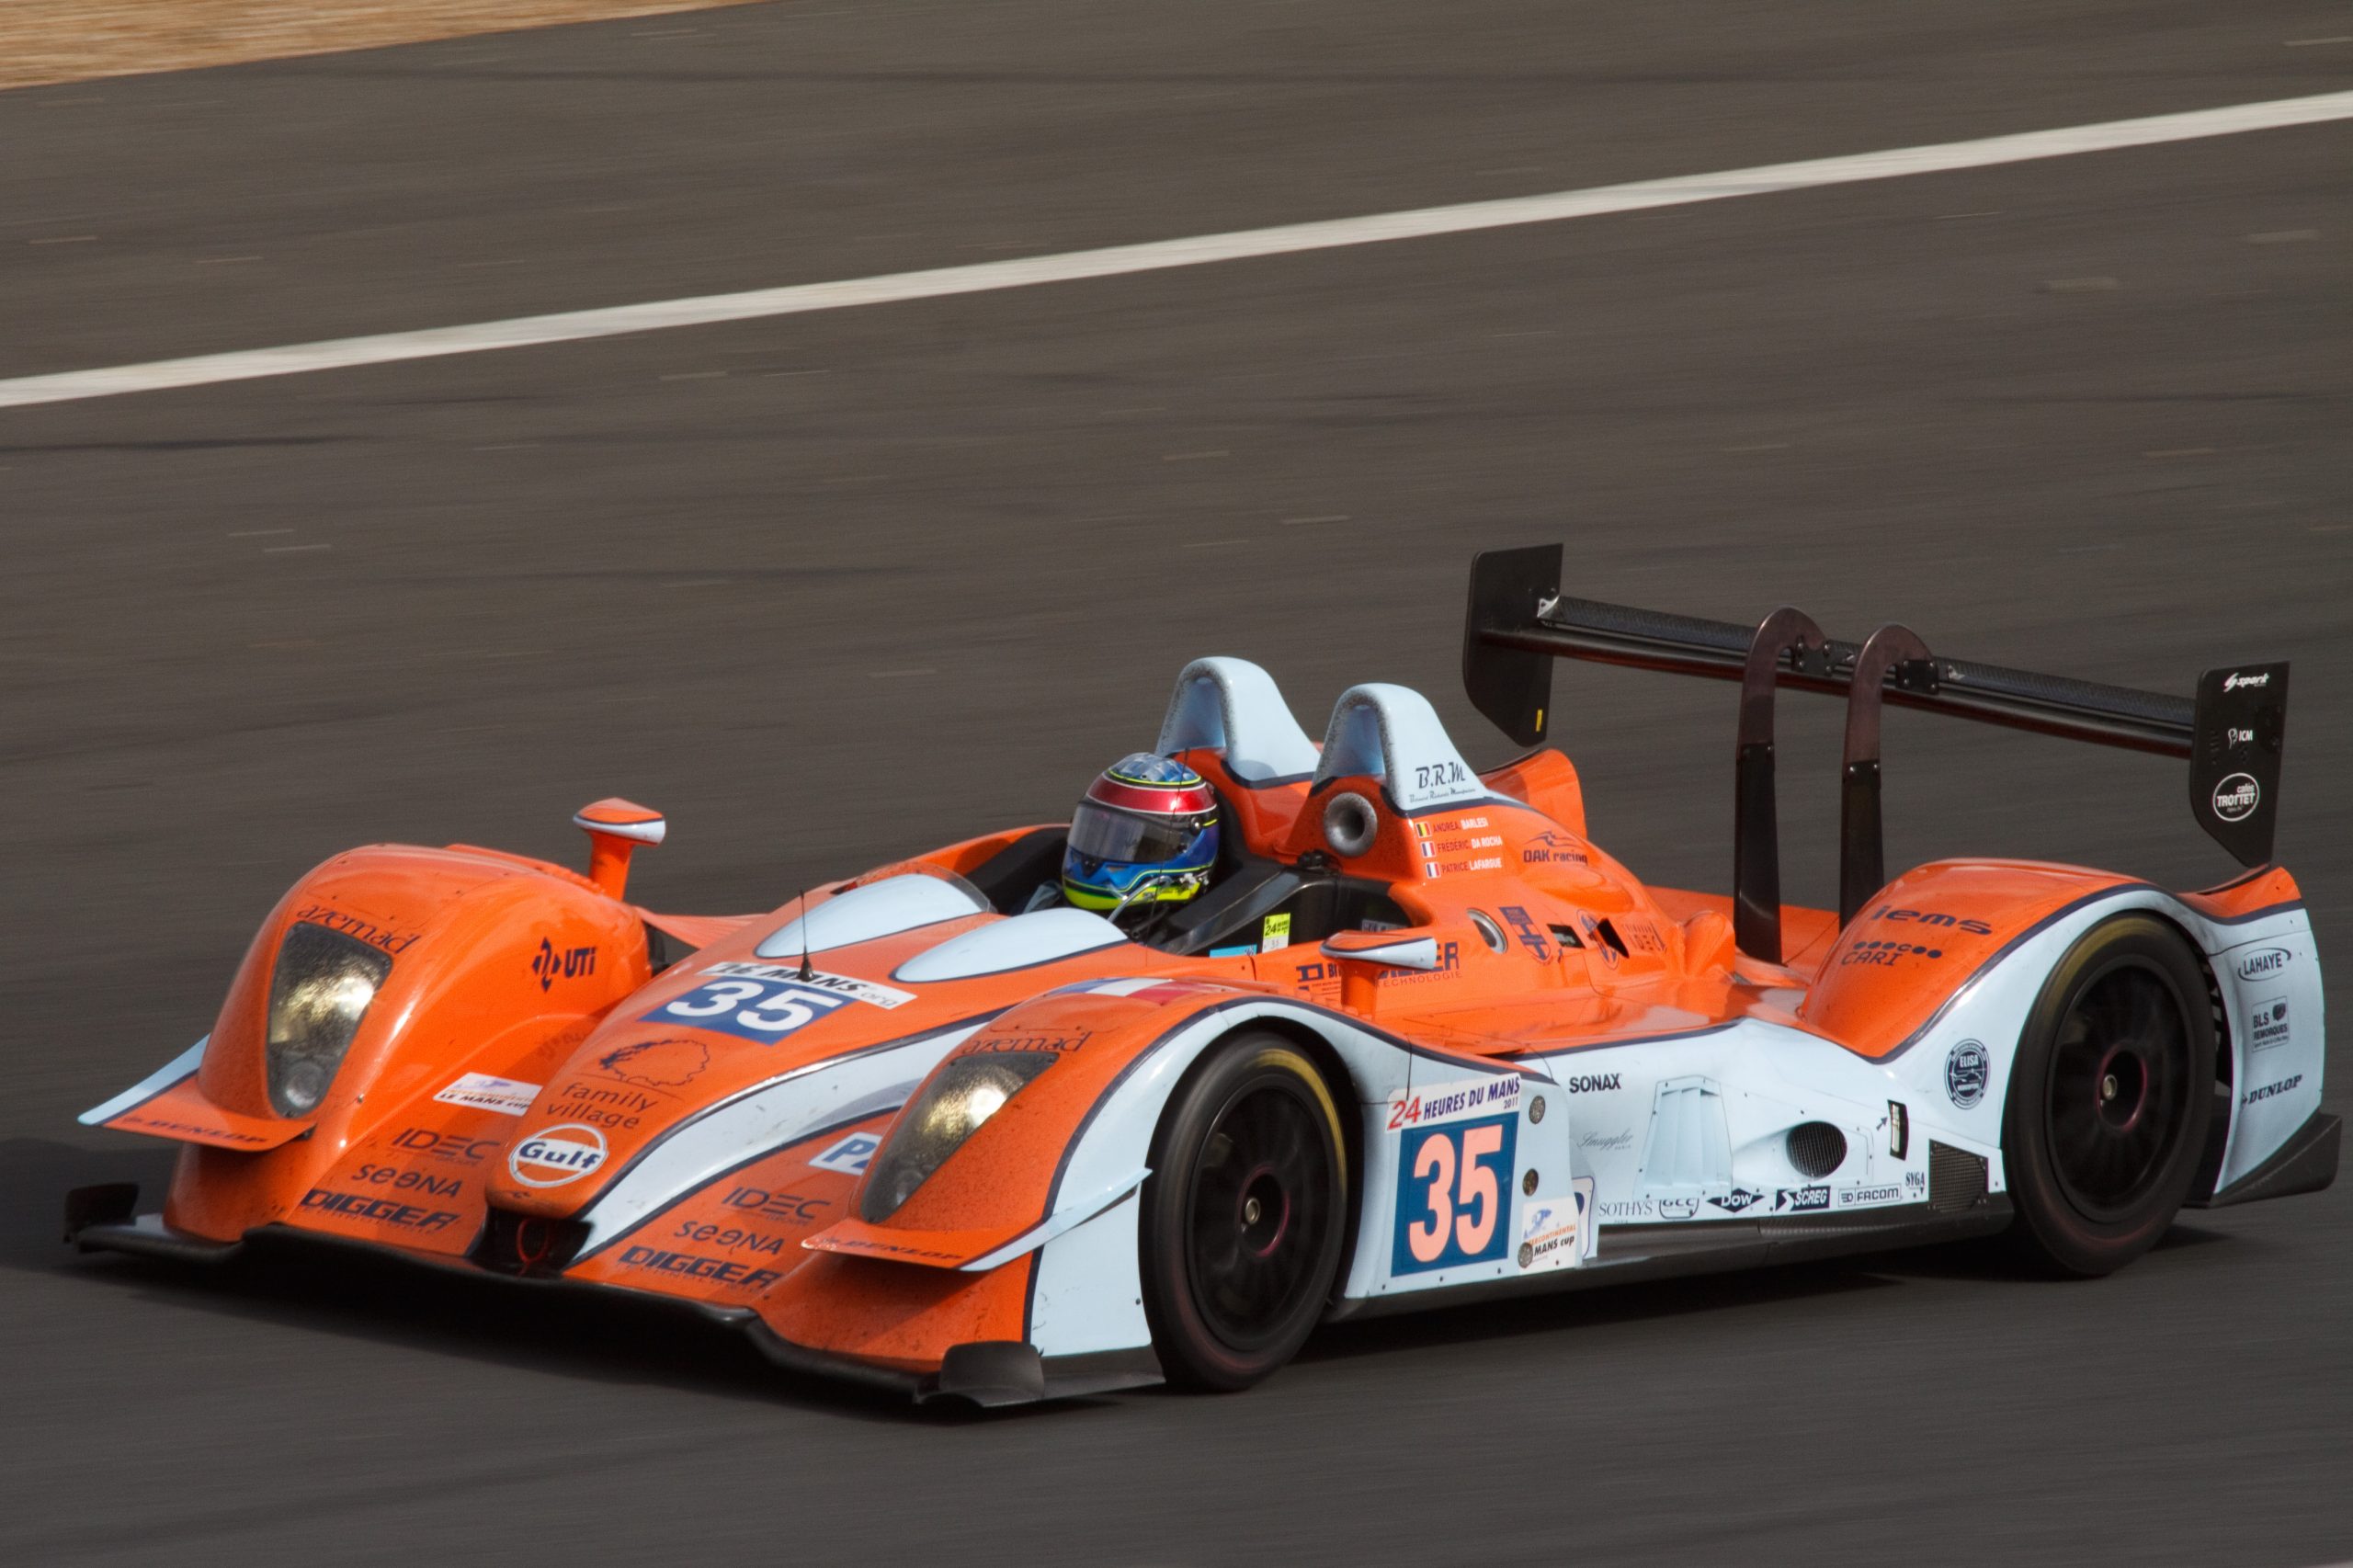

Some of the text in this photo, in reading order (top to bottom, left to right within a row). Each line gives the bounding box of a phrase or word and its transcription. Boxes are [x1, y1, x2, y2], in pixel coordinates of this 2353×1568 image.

[2217, 792, 2256, 807] TROTTET
[1481, 835, 1504, 847] ROCHA
[1841, 949, 1904, 967] CARI
[2243, 952, 2283, 976] LAHAYE
[665, 980, 845, 1031] 35
[2253, 1011, 2270, 1029] BLS
[1959, 1054, 1980, 1068] ELISA
[1569, 1073, 1622, 1094] SONAX
[2248, 1074, 2302, 1104] DUNLOP
[460, 1096, 506, 1106] MANS
[561, 1082, 659, 1114] family
[1387, 1076, 1520, 1131] 24 HEURES DU MANS
[546, 1103, 641, 1130] village
[392, 1128, 501, 1161] IDEC
[518, 1139, 601, 1170] Gulf
[1905, 1172, 1926, 1187] SYGA
[721, 1187, 832, 1221] IDEC
[1407, 1124, 1503, 1263] 35
[1794, 1188, 1828, 1206] SCREG
[299, 1188, 462, 1231] DIGGER
[1598, 1199, 1653, 1217] SOTHYS
[1534, 1238, 1558, 1257] MANS
[1560, 1235, 1575, 1247] cup
[618, 1244, 784, 1288] DIGGER
